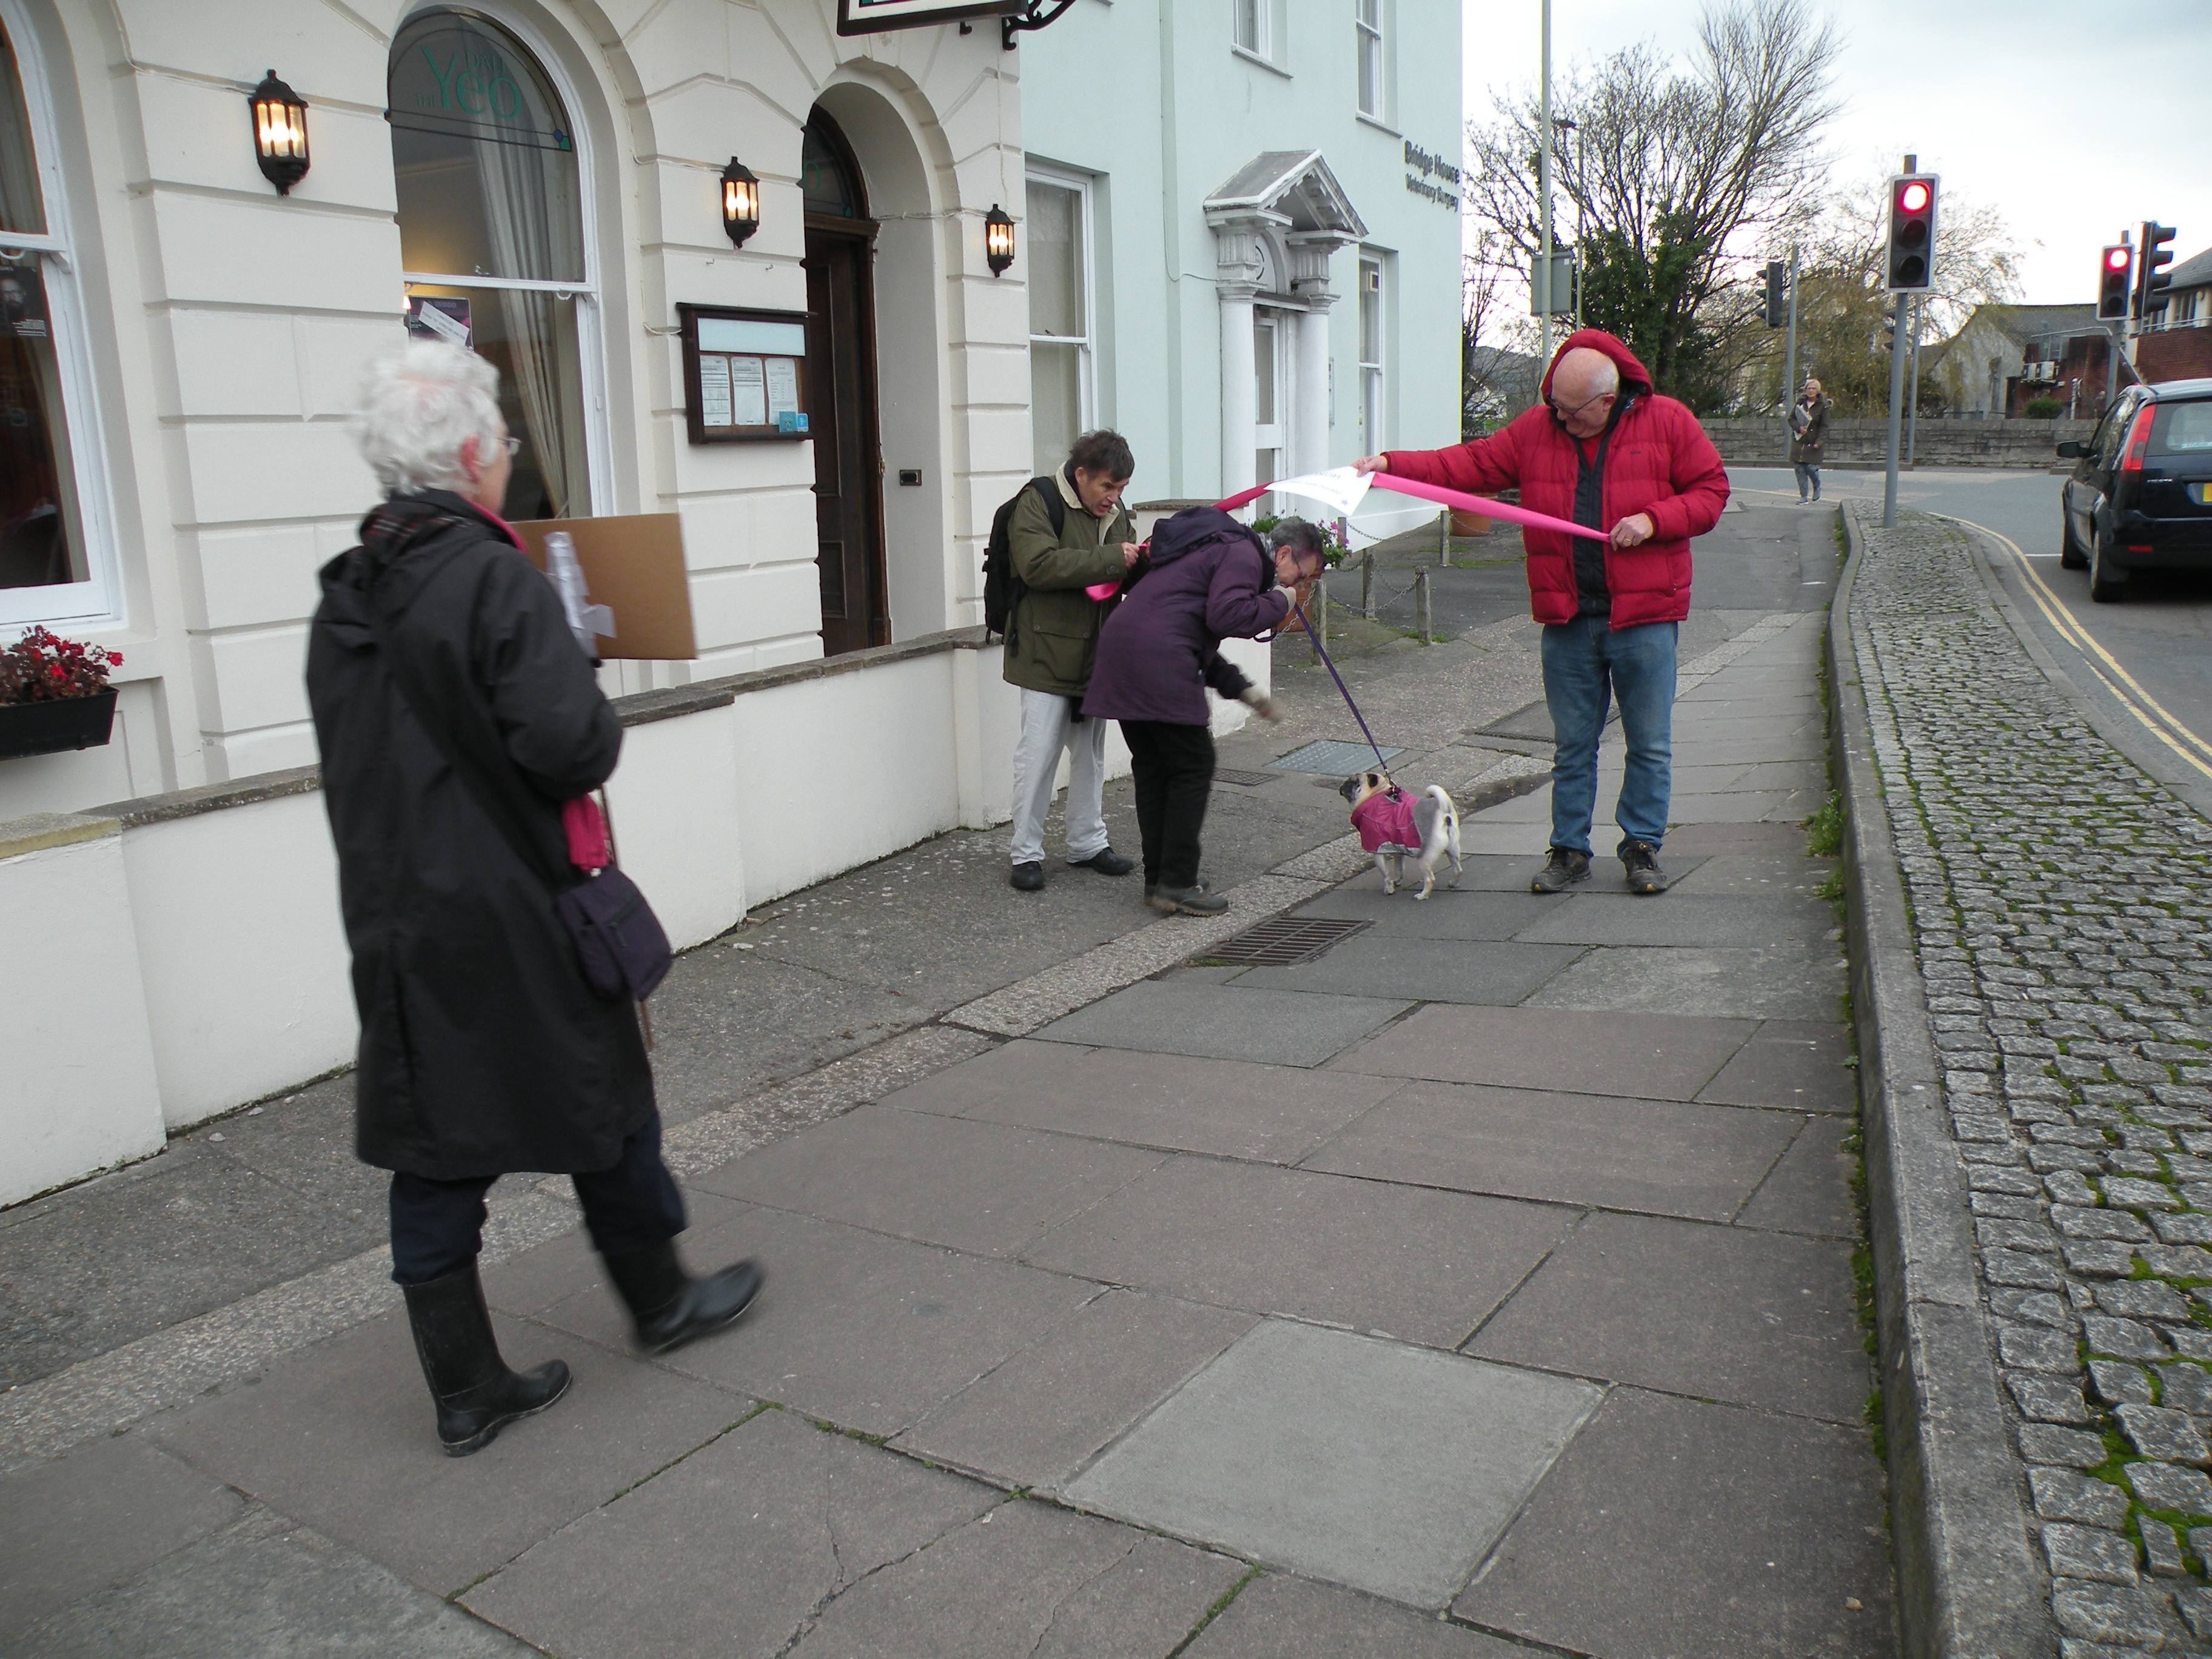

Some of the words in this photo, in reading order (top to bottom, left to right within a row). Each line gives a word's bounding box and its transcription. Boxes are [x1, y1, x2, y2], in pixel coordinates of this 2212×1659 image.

[421, 45, 521, 119] Yeo
[1404, 140, 1433, 176] Bridge
[1434, 153, 1460, 184] House
[1406, 173, 1436, 203] Veterinary
[1436, 186, 1459, 213] Surgery
